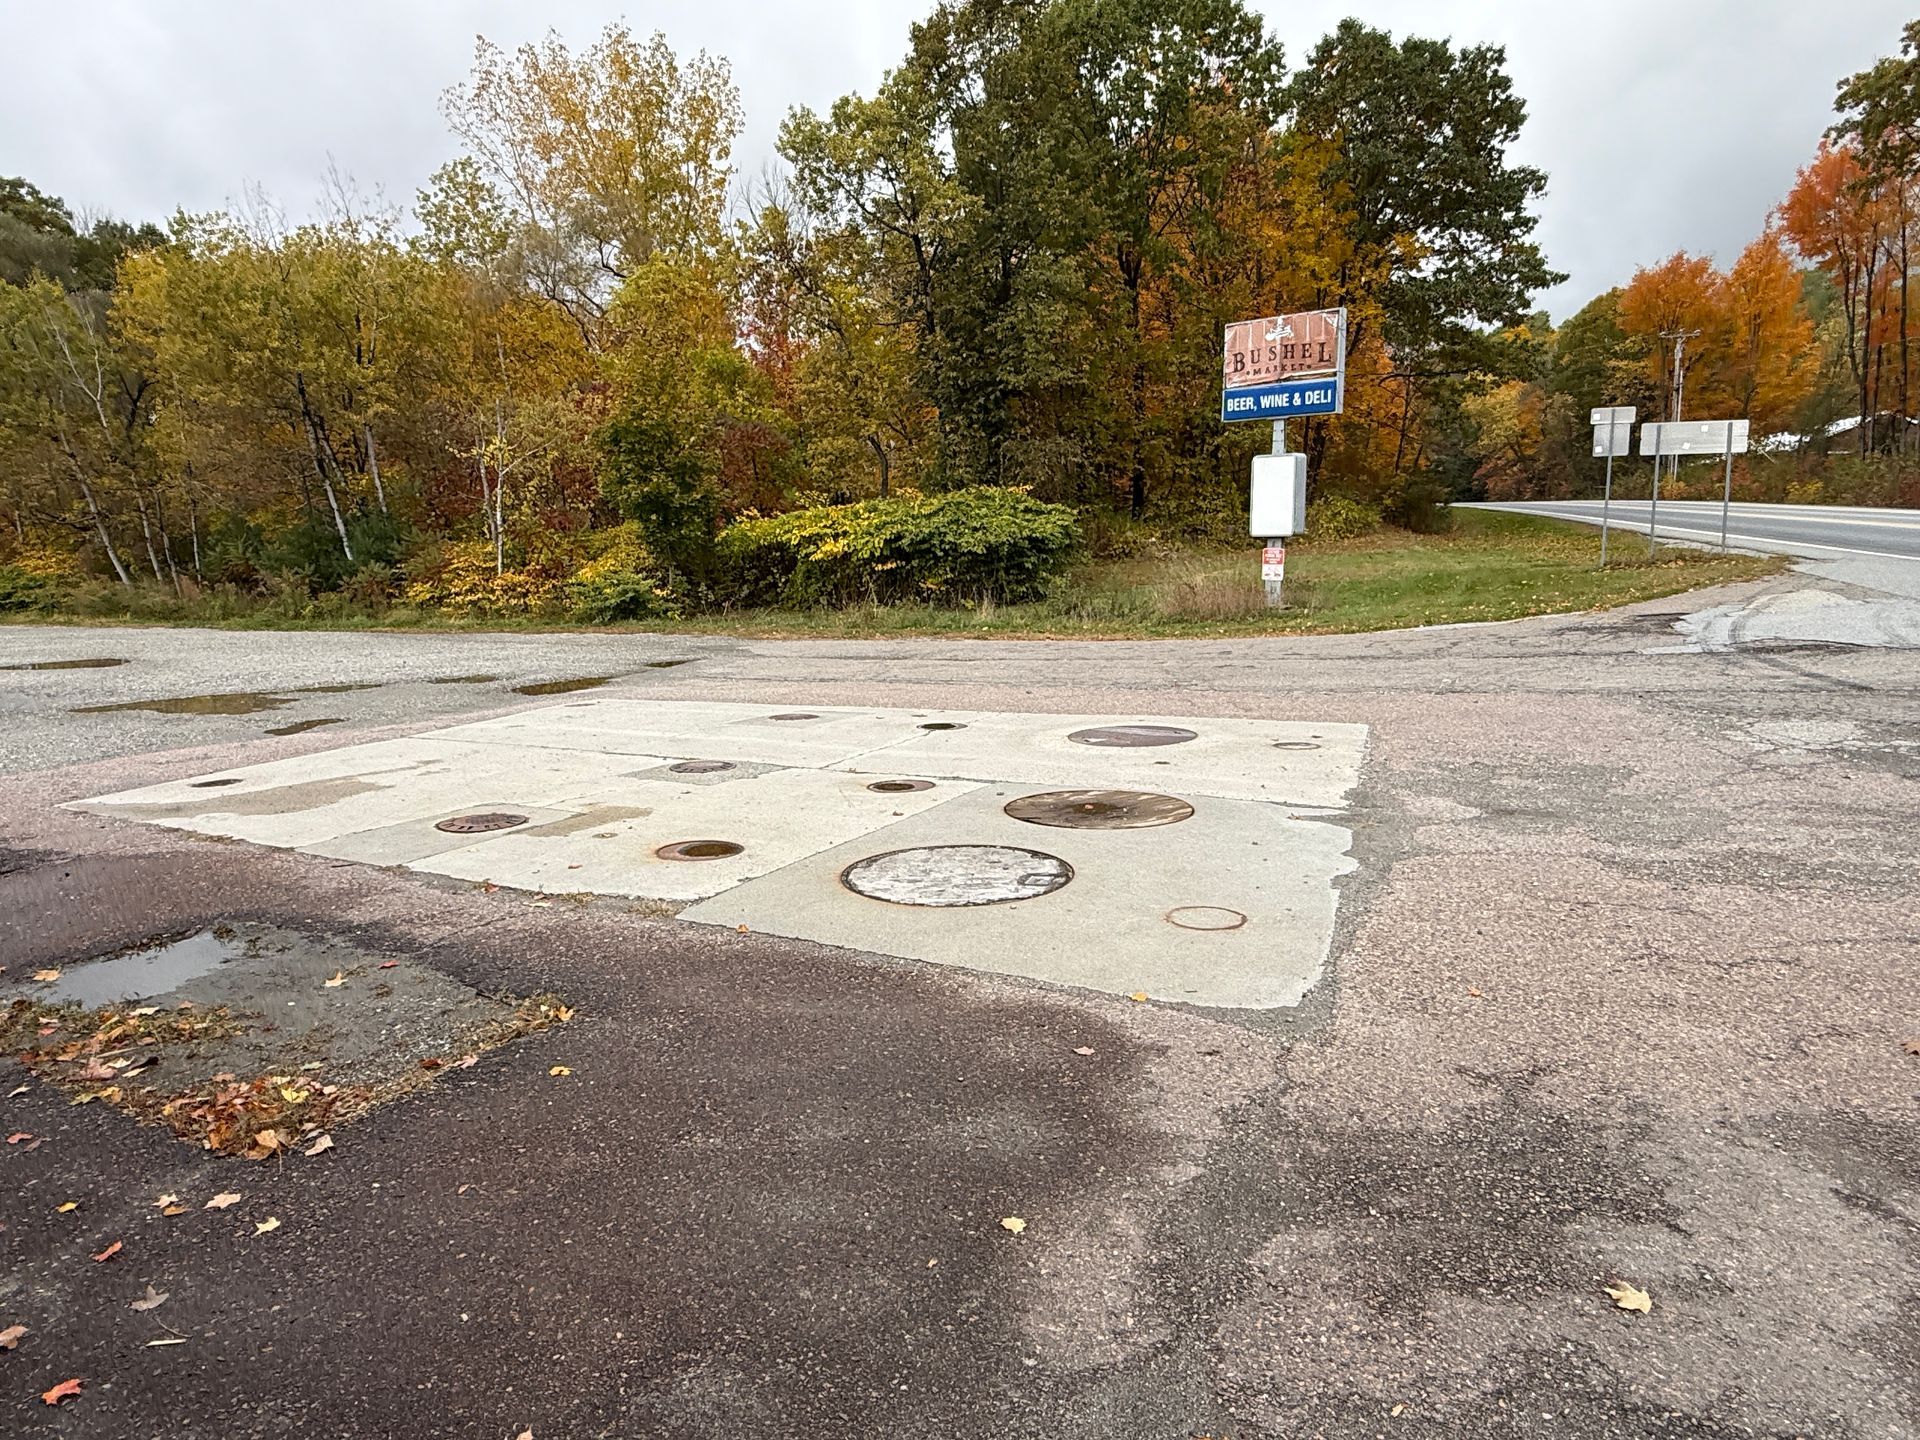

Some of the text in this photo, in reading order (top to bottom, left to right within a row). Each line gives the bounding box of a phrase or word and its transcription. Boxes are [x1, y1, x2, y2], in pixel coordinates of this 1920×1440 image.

[1233, 342, 1331, 373] BUSHEL
[1253, 363, 1304, 375] MARKET
[1227, 390, 1331, 411] BEER, WINE & DELI
